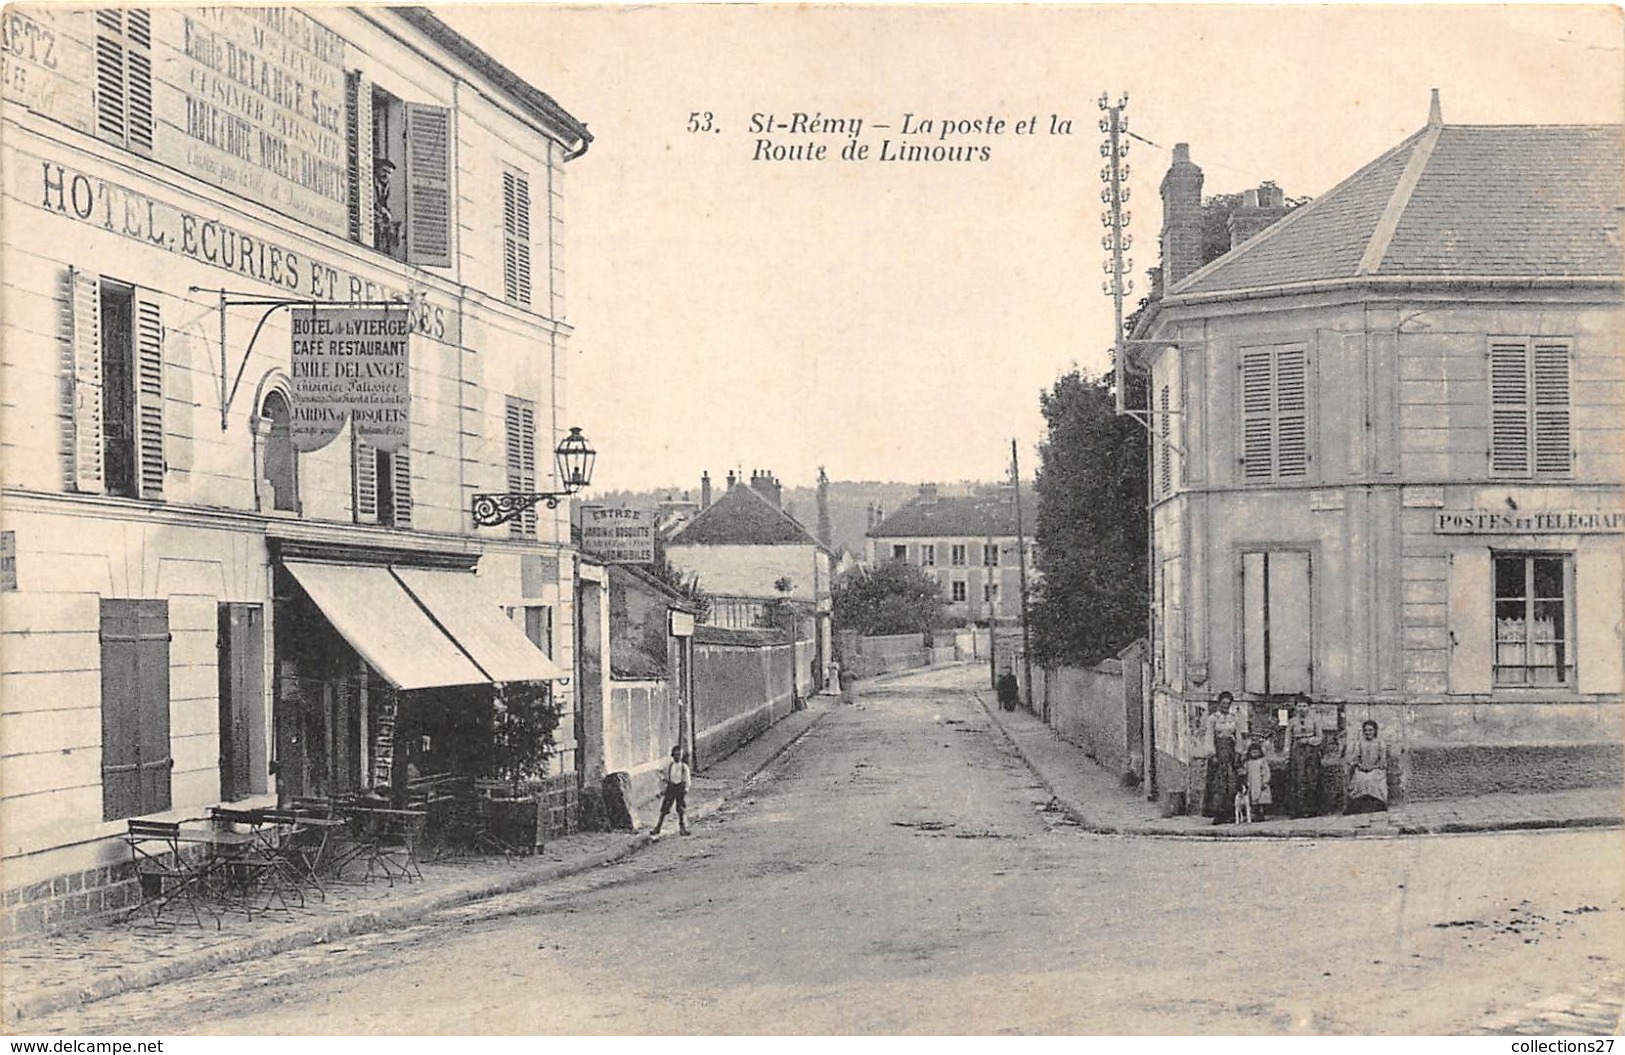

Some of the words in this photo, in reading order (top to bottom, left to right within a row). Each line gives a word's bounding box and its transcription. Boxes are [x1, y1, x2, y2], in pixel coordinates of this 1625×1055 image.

[226, 41, 304, 115] DELANGE
[311, 261, 338, 300] ET
[354, 319, 407, 336] VIERGE
[329, 340, 406, 356] RESTAURANT
[293, 361, 330, 378] EMILE
[335, 361, 405, 379] DELANGE
[292, 407, 336, 422] JARDIN
[351, 408, 407, 423] BOSQUETS
[1439, 513, 1513, 529] POSTES
[1516, 518, 1531, 529] ET
